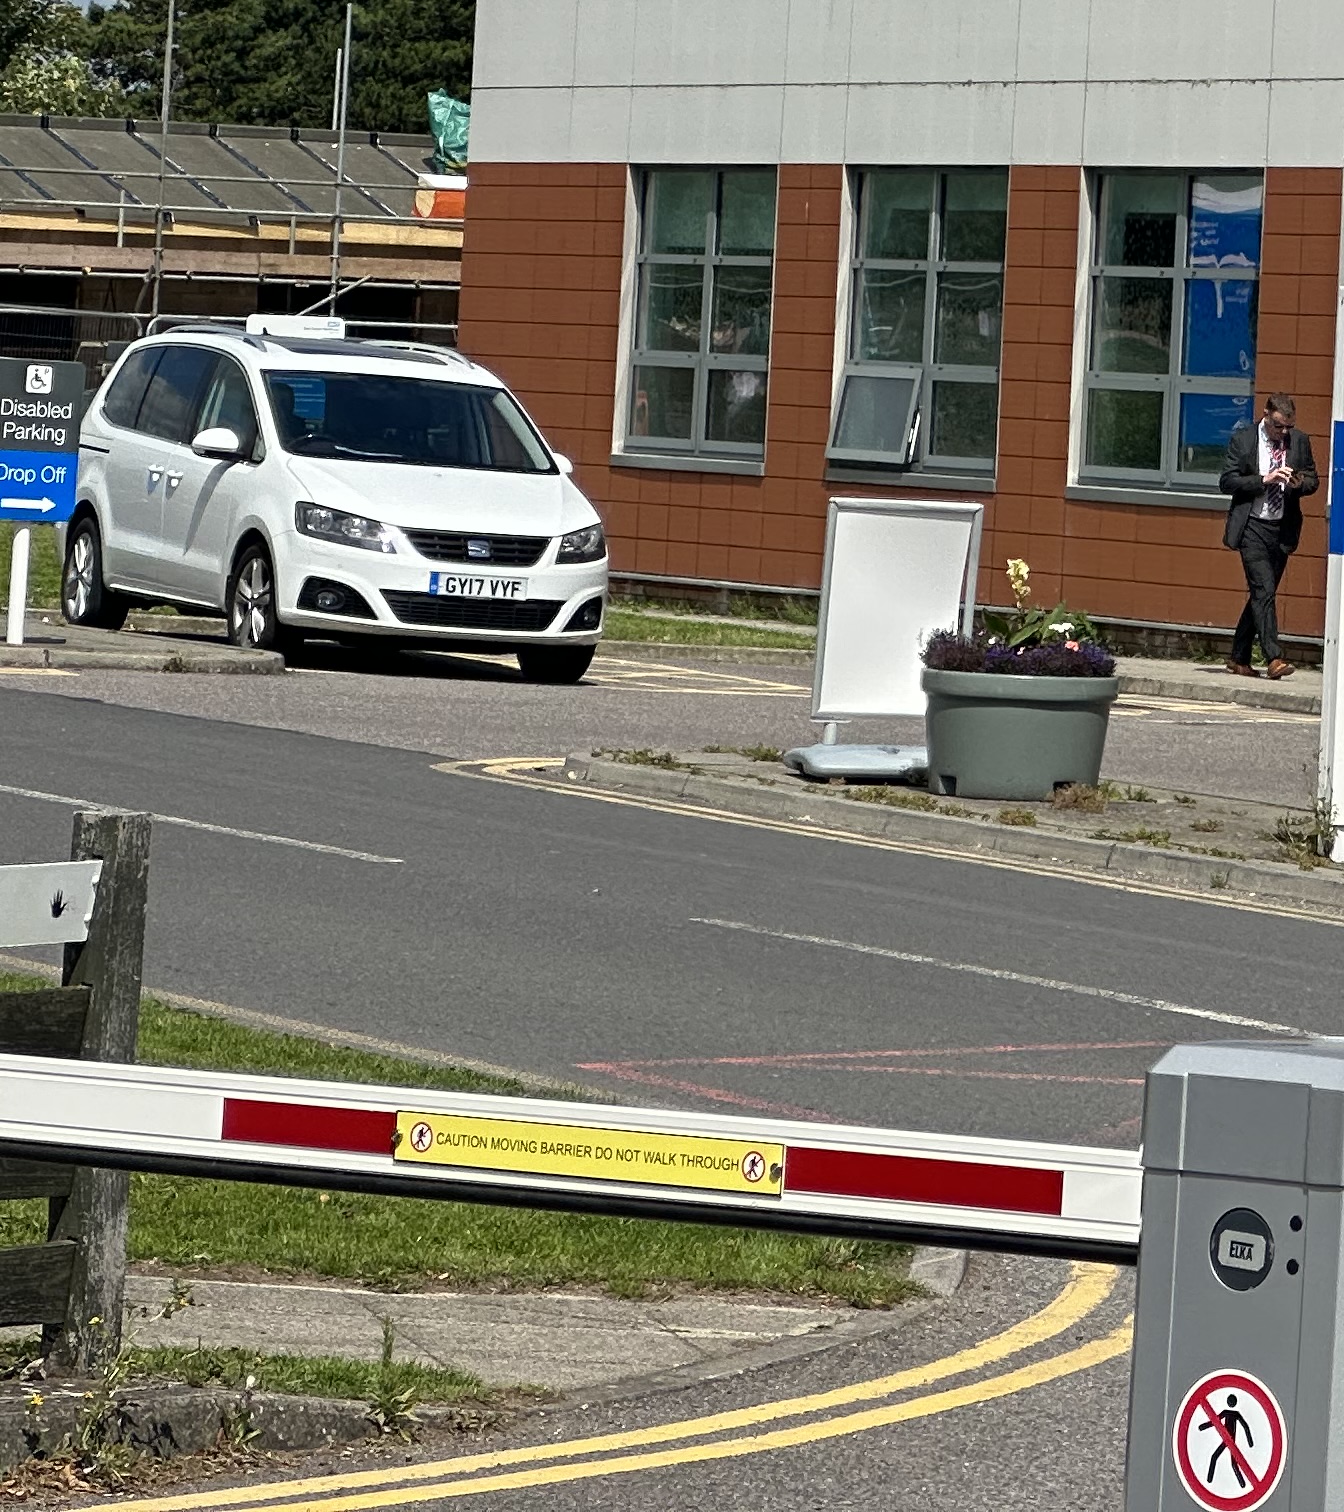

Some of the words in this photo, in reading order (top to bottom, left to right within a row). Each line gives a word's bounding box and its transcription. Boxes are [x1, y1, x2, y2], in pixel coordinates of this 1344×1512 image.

[1, 398, 73, 419] Disabled
[3, 422, 66, 446] Parking
[0, 464, 36, 485] Drop
[41, 465, 67, 484] Off
[446, 577, 485, 595] GY17
[490, 580, 522, 597] VYF
[436, 1132, 488, 1150] CAUTION
[490, 1136, 538, 1155] MOVING
[540, 1141, 593, 1159] BARRIER
[595, 1146, 613, 1161] DO
[615, 1147, 641, 1163] NOT
[643, 1151, 677, 1167] WALK
[680, 1154, 740, 1173] THROUGH
[1230, 1240, 1254, 1261] ELKA
